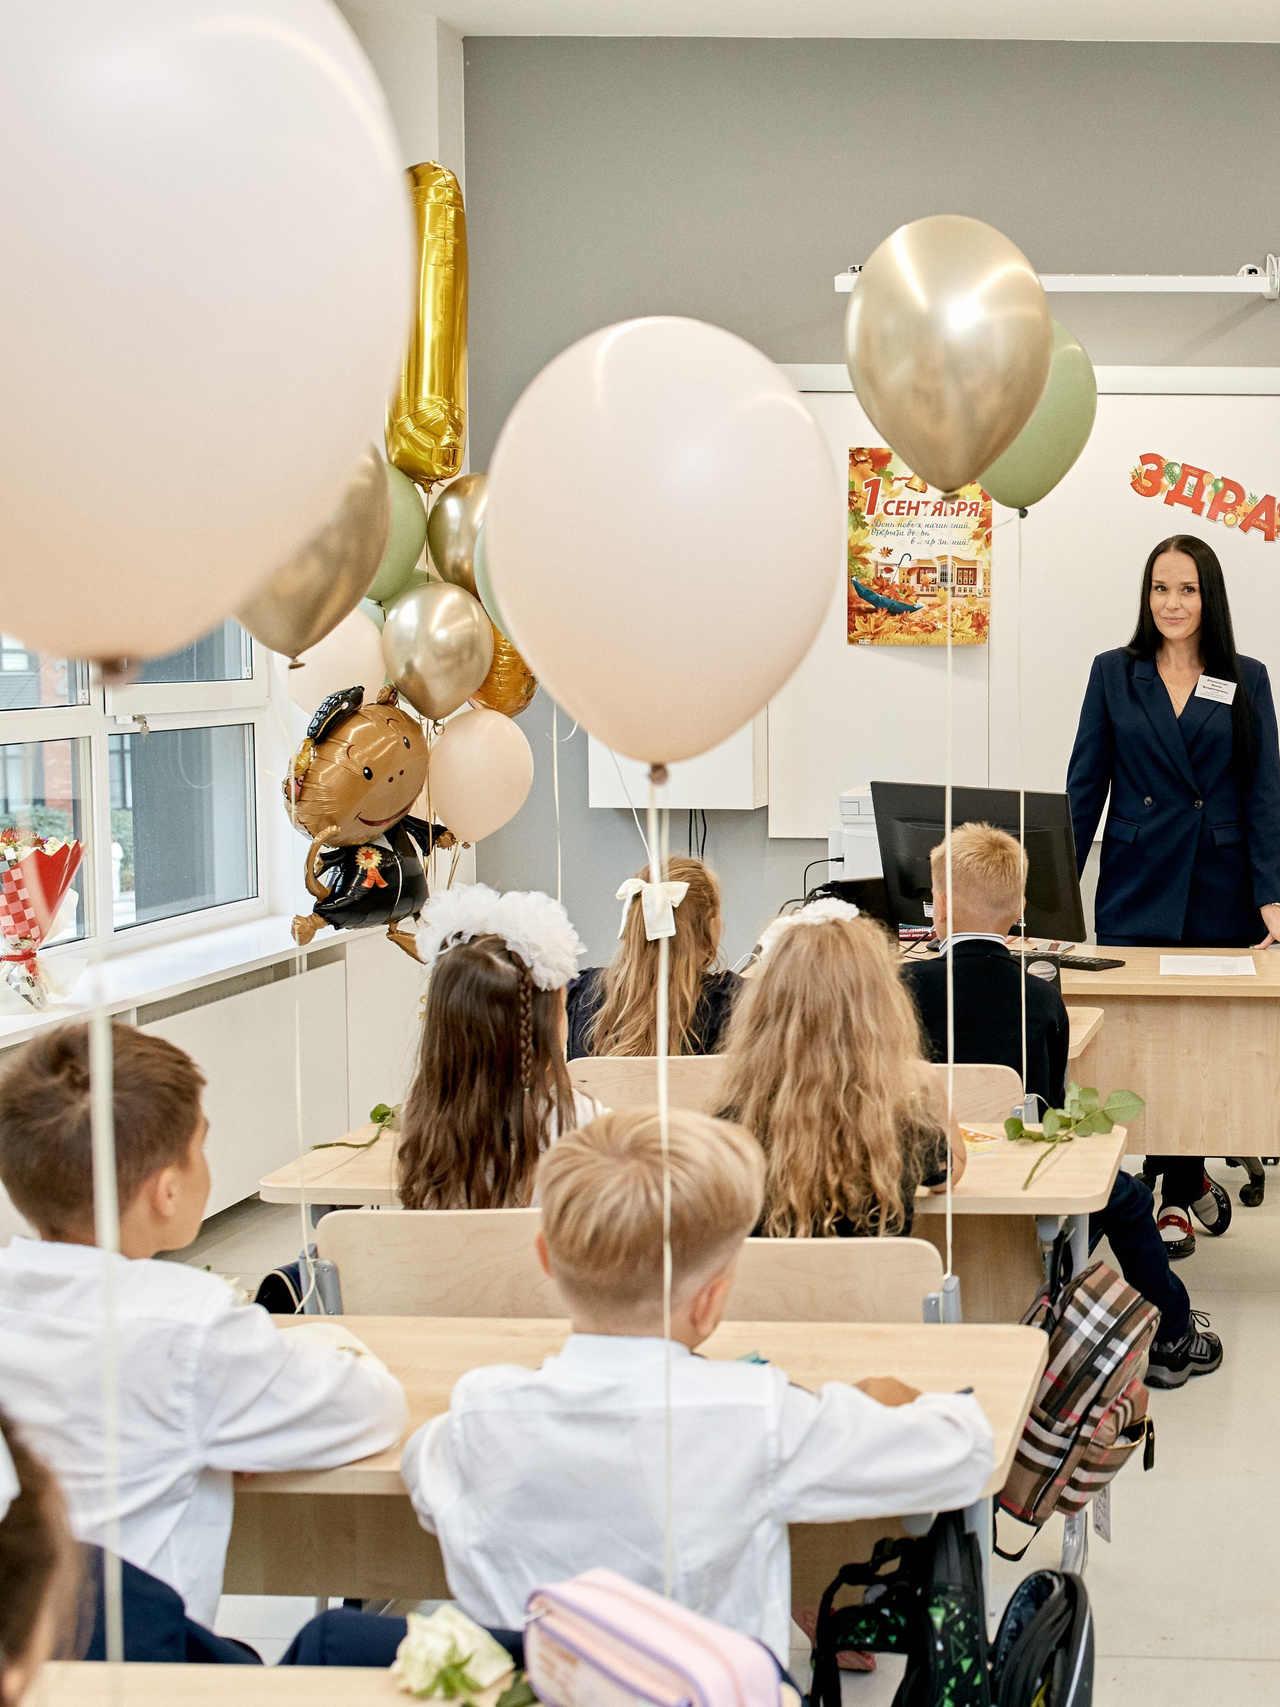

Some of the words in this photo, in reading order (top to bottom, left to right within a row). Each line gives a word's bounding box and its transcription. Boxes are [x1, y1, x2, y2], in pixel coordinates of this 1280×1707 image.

[864, 478, 881, 516] 1
[883, 500, 980, 517] СЕНТЯБРЯ
[871, 518, 895, 528] День
[871, 528, 904, 538] Открыта
[907, 528, 929, 537] дврь
[917, 538, 936, 547] ир
[938, 537, 971, 546] знний!
